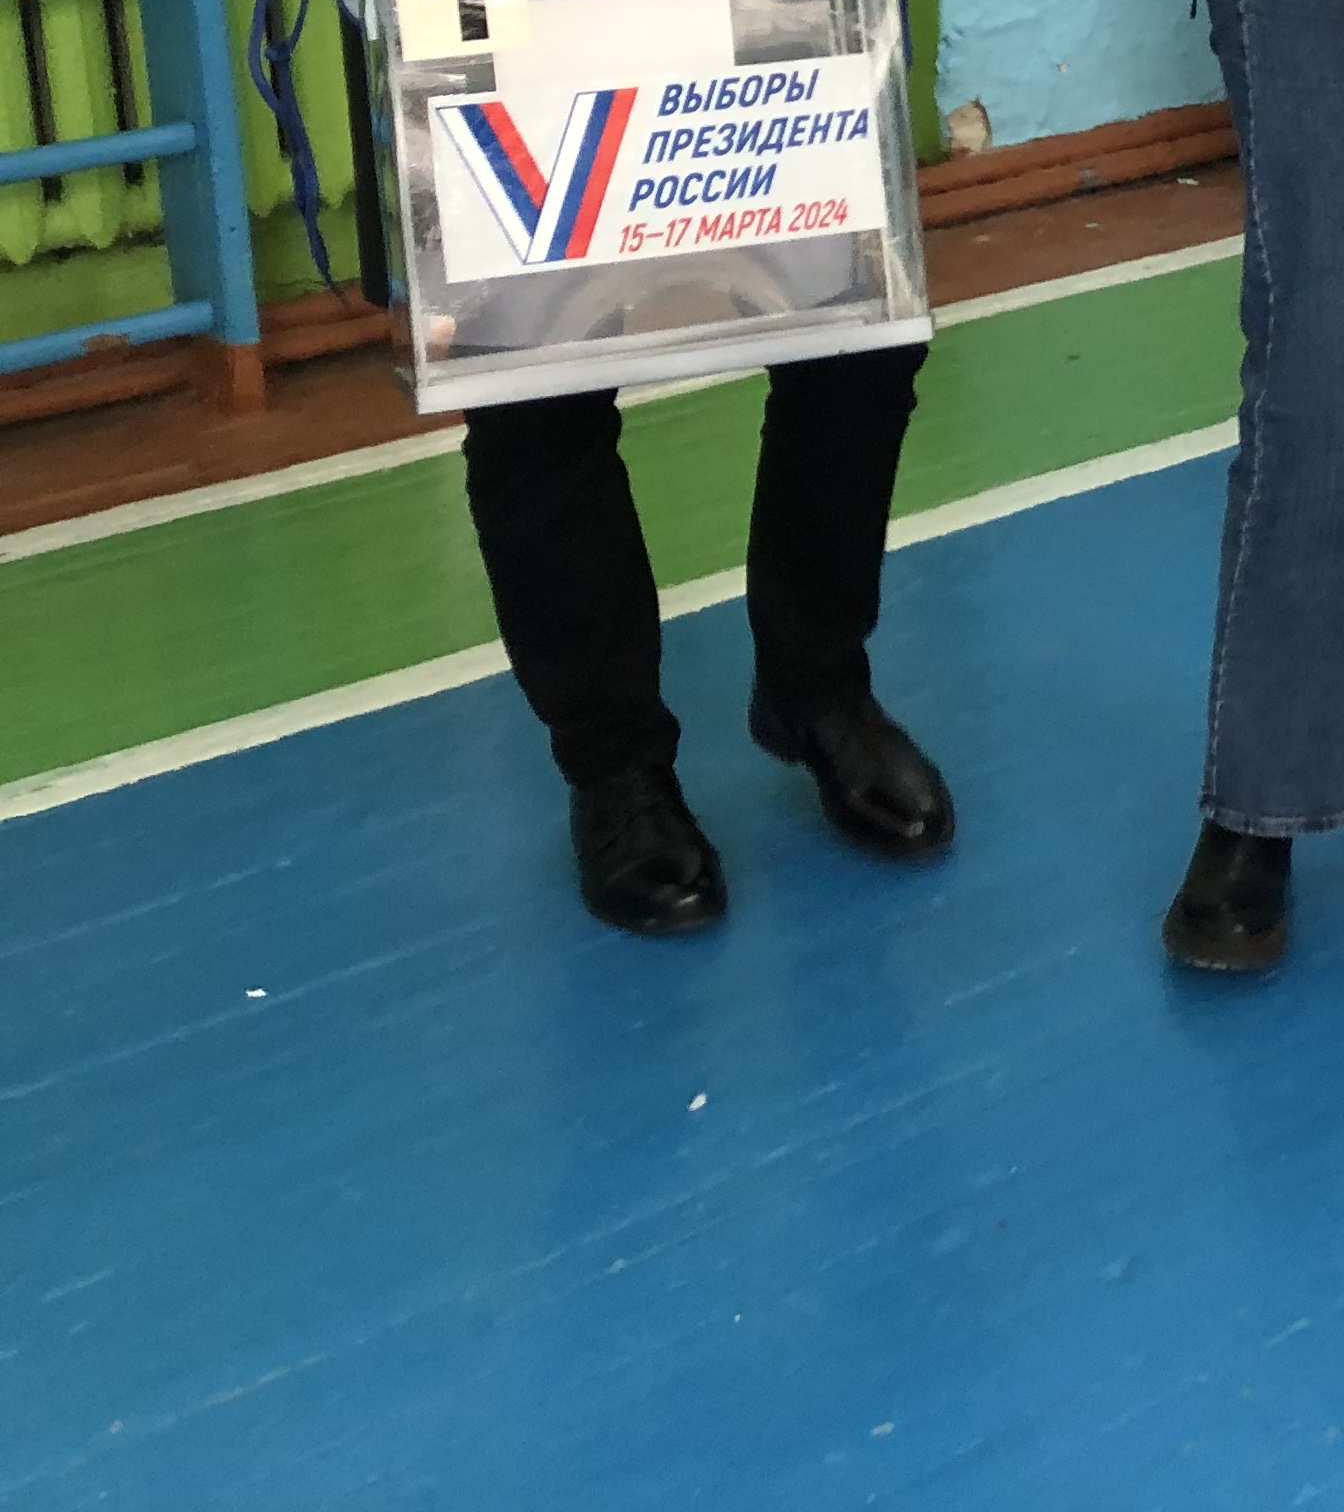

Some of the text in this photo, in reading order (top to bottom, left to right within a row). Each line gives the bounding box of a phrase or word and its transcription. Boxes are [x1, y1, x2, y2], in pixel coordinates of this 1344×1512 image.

[656, 68, 821, 118] ВЫБОРЫ
[641, 107, 871, 165] ПРЕЗИДЕНТА
[627, 163, 778, 213] РОССИИ
[617, 197, 851, 256] 15–17 МАРТА 2024
